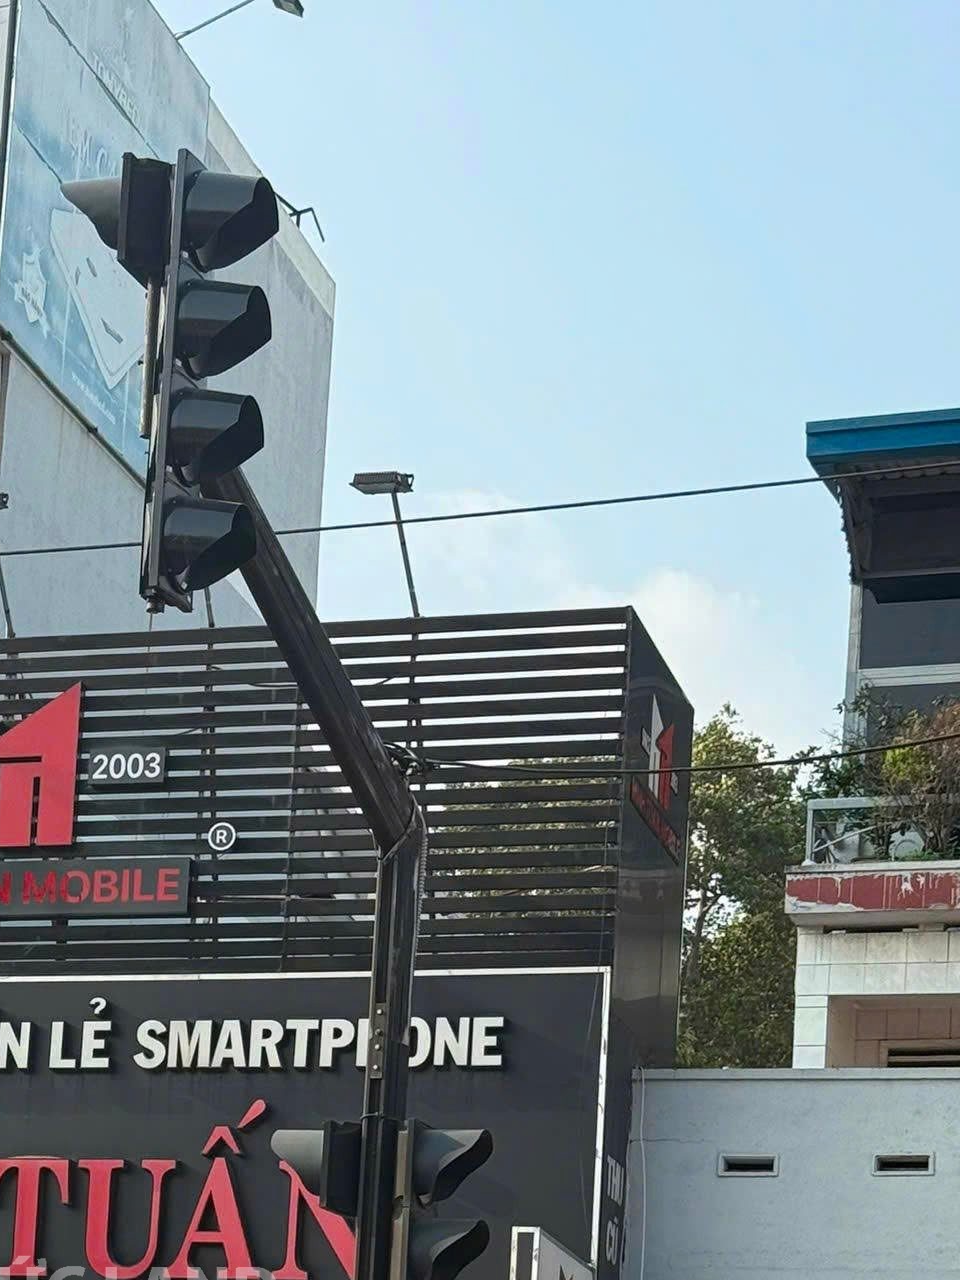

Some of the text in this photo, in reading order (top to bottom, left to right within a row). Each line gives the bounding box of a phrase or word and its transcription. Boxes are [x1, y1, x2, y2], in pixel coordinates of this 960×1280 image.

[92, 753, 161, 780] 2003
[23, 868, 181, 905] MOBILE
[49, 997, 112, 1069] LẺ
